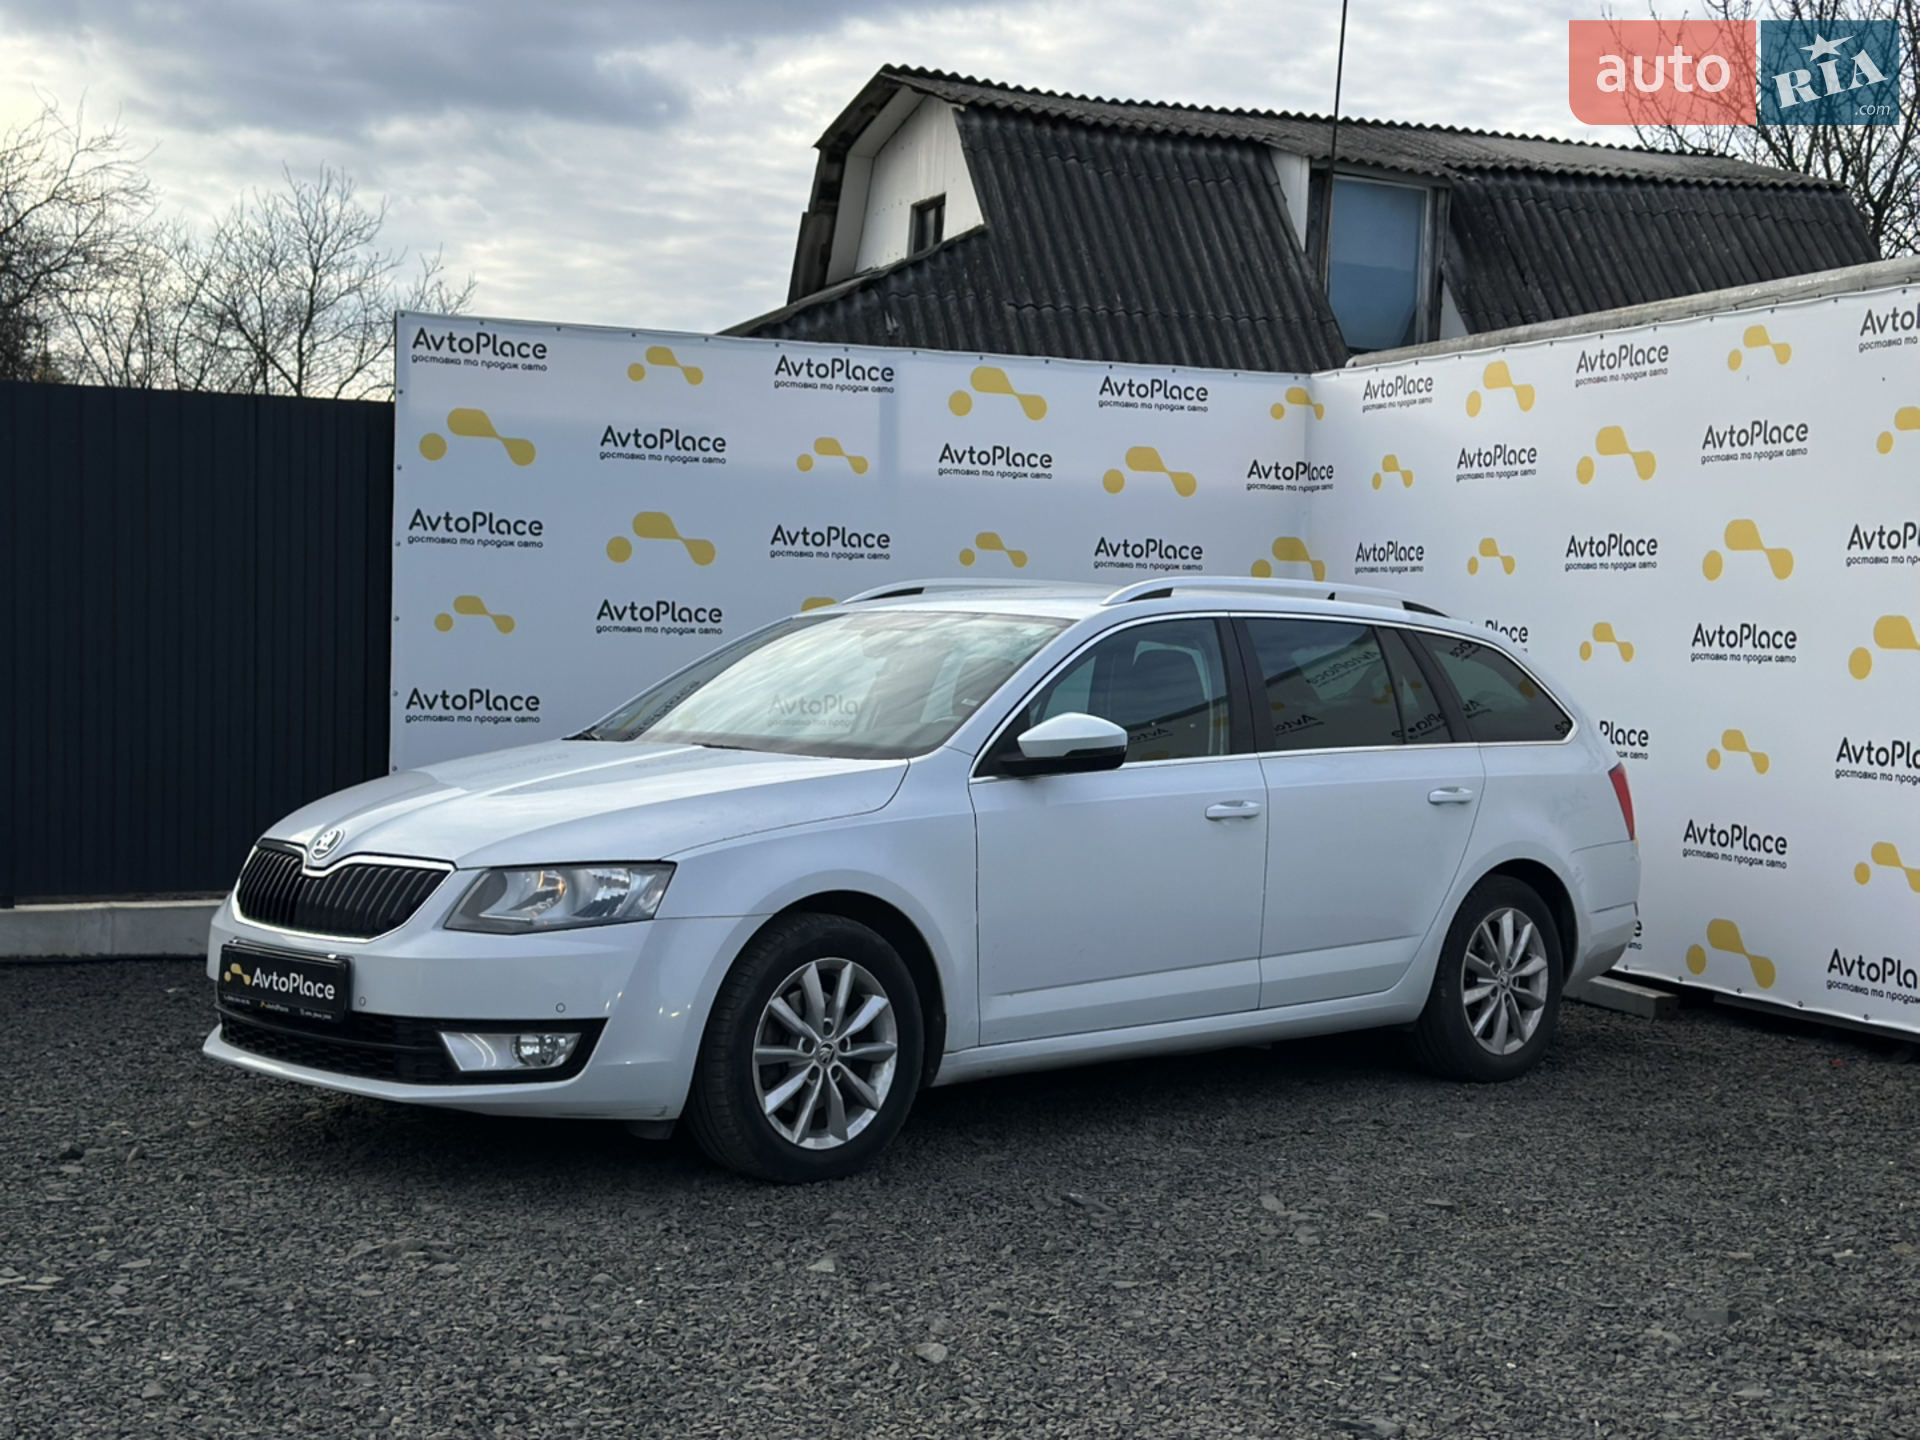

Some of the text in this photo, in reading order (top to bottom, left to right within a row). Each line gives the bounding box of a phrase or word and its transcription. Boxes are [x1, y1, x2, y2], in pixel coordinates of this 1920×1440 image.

[1860, 302, 1920, 337] Avto
[412, 327, 548, 360] AvtoPlace
[774, 354, 895, 383] AvtoPlace
[1576, 343, 1669, 374] AvtoPlace
[1099, 375, 1209, 402] AvtoPlace
[1363, 374, 1434, 401] AvtoPlace
[600, 425, 727, 453] AvtoPlace
[1702, 419, 1809, 450] AvtoPlace
[938, 443, 1053, 469] AvtoPlace
[1457, 444, 1537, 470] AvtoPlace
[1247, 459, 1334, 481] AvtoPlace
[408, 508, 544, 537] AvtoPlace
[770, 524, 891, 549] AvtoPlace
[1094, 537, 1203, 561] AvtoPlace
[1565, 533, 1658, 558] AvtoPlace
[1355, 541, 1425, 563] AvtoPlace
[596, 599, 723, 624] AvtoPlace
[1691, 623, 1797, 650] AvtoPlace
[405, 687, 540, 712] AvtoPlace
[1600, 720, 1650, 748] Place
[1683, 819, 1788, 856] AvtoPlace
[251, 967, 336, 1001] AvtoPlace
